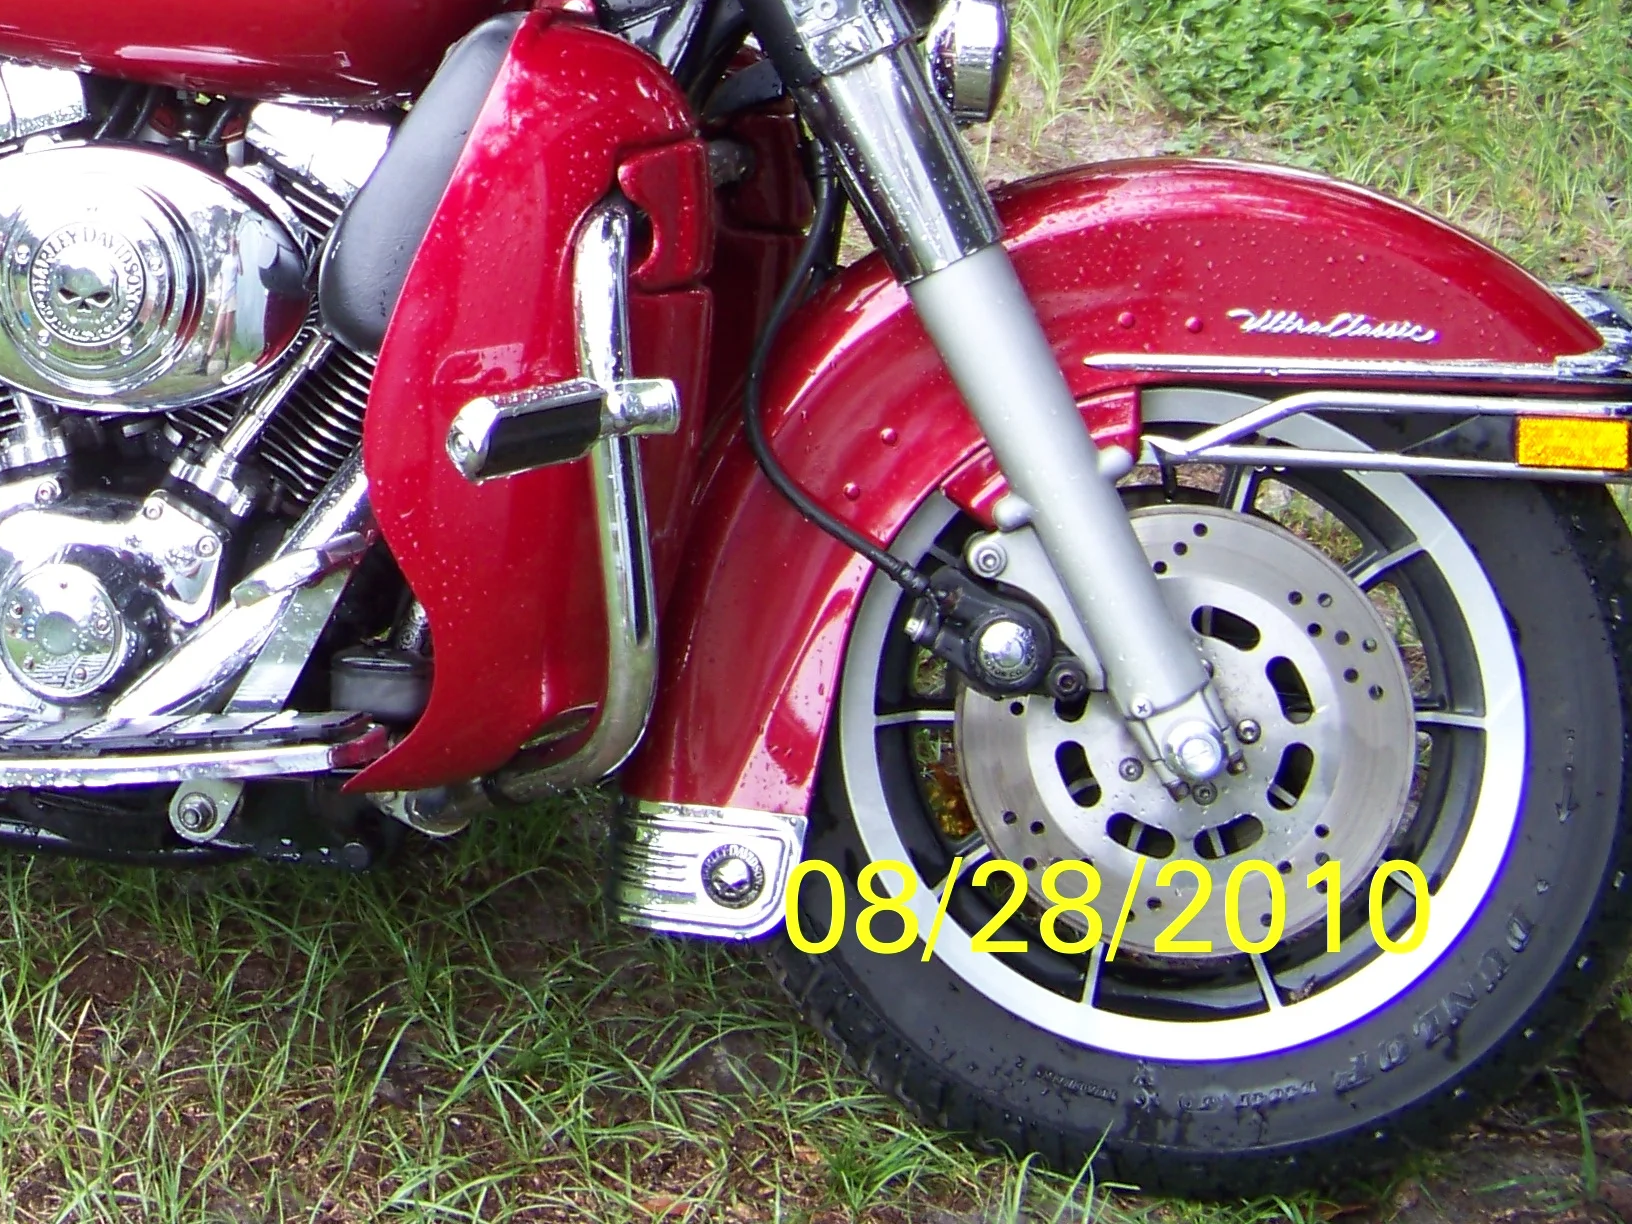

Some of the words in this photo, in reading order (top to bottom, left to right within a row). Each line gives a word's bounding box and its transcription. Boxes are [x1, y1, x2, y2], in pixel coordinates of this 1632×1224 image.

[31, 229, 77, 293] HARLEY
[82, 226, 144, 304] DAVIDSON
[1226, 307, 1326, 334] Ultra
[1327, 312, 1437, 343] Classic
[1333, 909, 1534, 1095] DUNLOP
